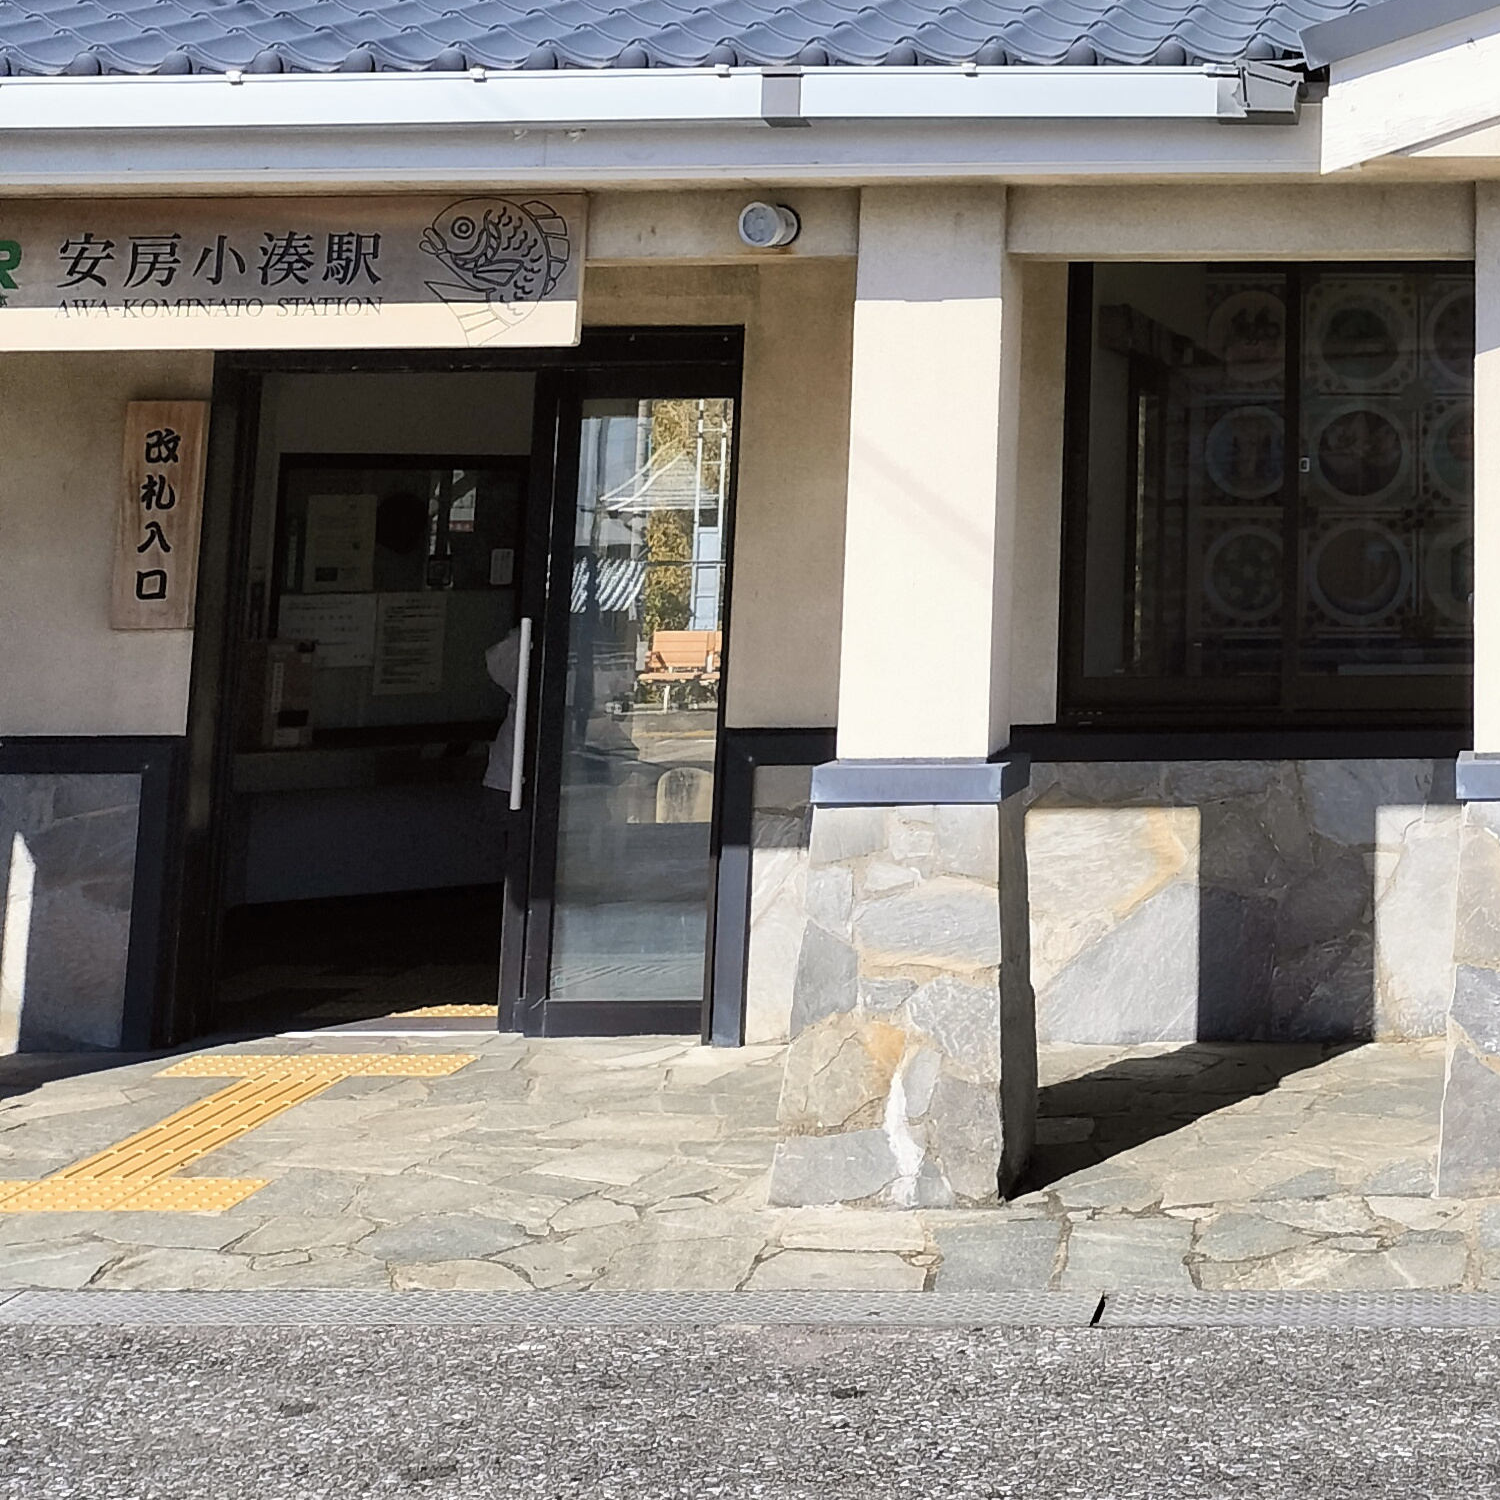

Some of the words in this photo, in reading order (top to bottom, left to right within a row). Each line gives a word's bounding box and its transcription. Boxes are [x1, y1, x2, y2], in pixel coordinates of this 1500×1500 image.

[0, 240, 21, 289] R
[56, 231, 382, 288] 安房小湊駅
[54, 297, 264, 319] AWA-KOMINATO
[276, 296, 383, 317] STATION
[136, 428, 181, 600] 改札入口
